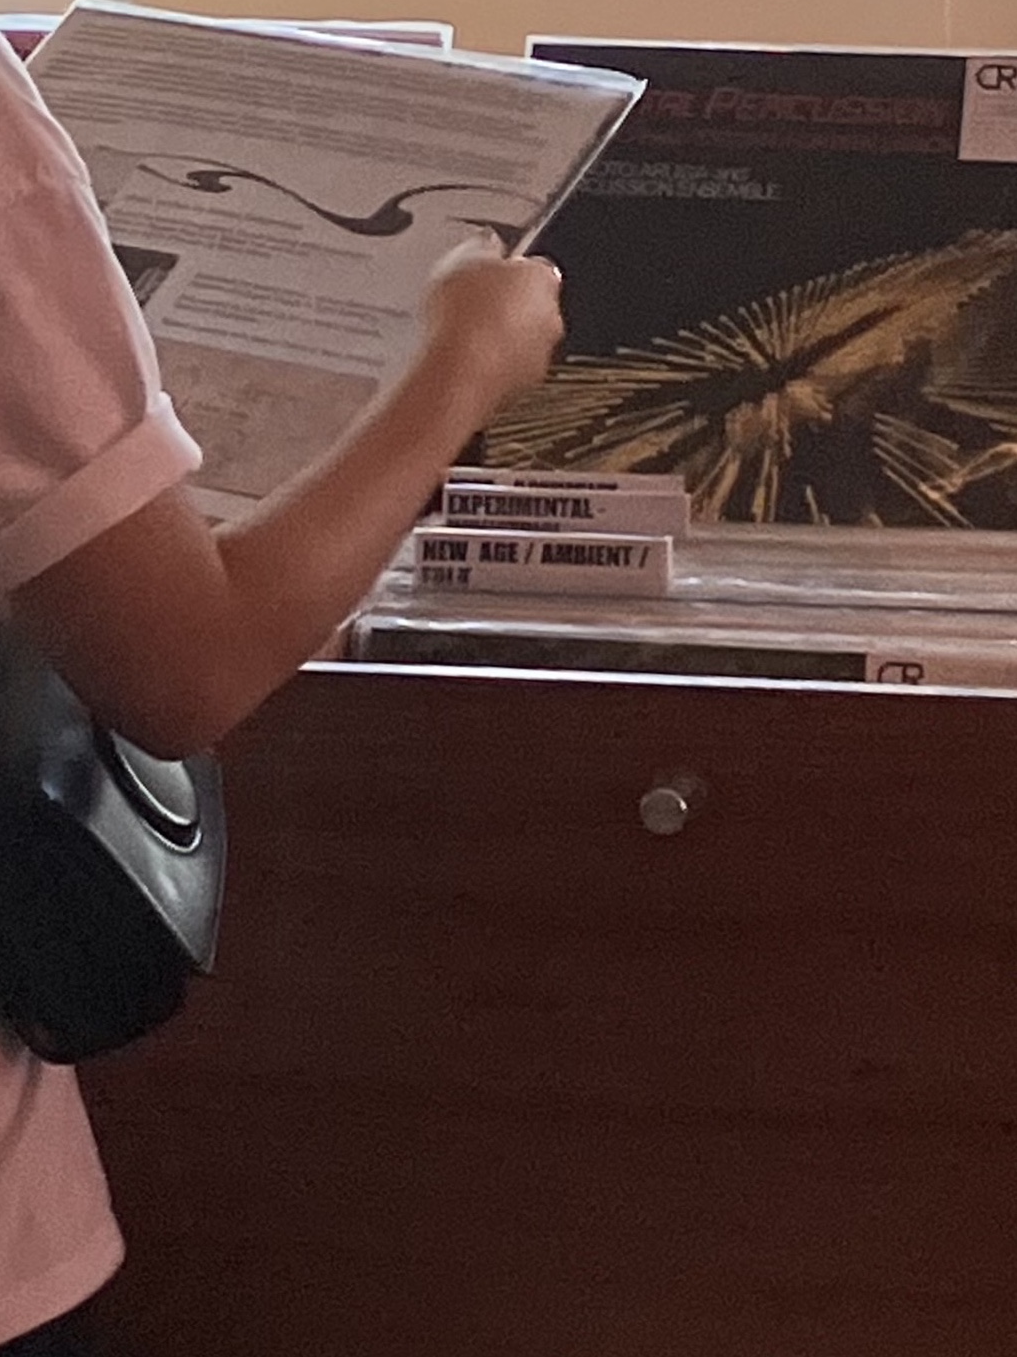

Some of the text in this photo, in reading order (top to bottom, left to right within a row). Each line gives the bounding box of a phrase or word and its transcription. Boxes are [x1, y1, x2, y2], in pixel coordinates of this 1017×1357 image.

[448, 495, 594, 518] EXPERIMENTAL
[422, 540, 469, 562] NEW
[479, 541, 519, 563] AGE
[540, 543, 635, 567] AMBIENT
